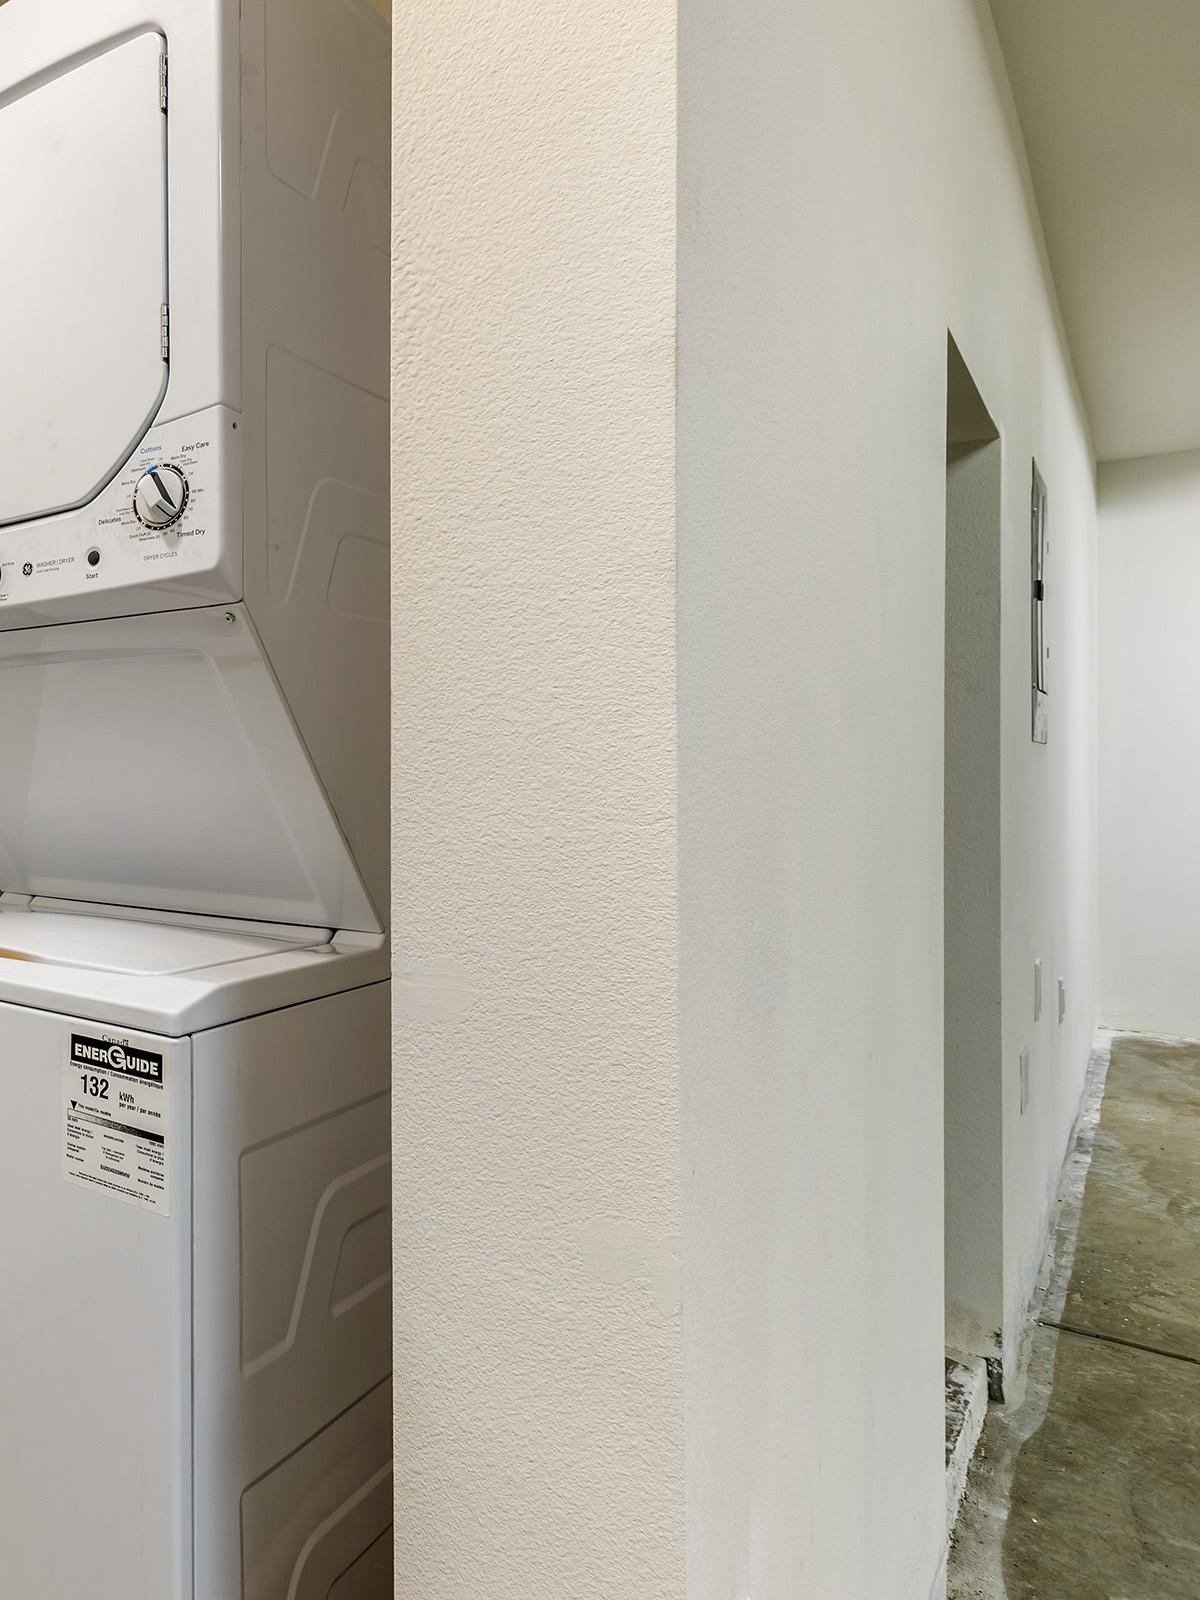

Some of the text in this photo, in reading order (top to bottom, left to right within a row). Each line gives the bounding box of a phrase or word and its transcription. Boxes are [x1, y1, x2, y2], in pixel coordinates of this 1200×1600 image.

[140, 445, 162, 454] Cottons
[182, 440, 210, 452] Easy Care
[98, 518, 122, 526] Delicates
[176, 530, 195, 538] Timed
[36, 560, 56, 568] WASHER
[74, 1043, 159, 1076] ENERGUIDE
[70, 1061, 82, 1069] Energy
[83, 1064, 107, 1075] consumption
[81, 1074, 109, 1100] 132
[120, 1092, 134, 1103] kWh
[148, 1109, 161, 1118] année
